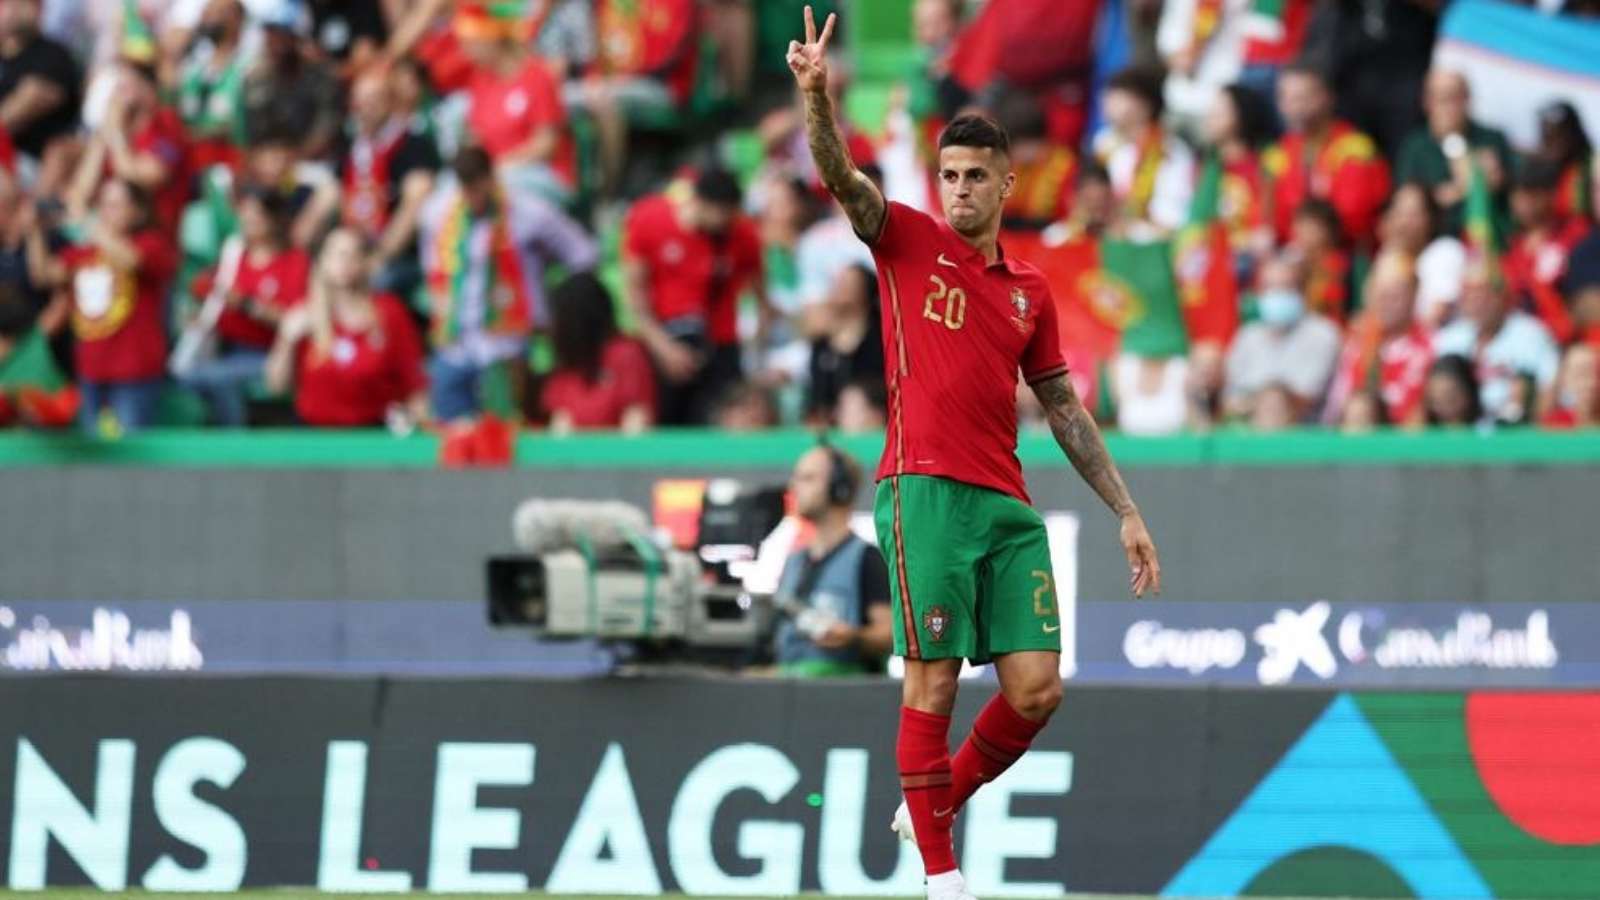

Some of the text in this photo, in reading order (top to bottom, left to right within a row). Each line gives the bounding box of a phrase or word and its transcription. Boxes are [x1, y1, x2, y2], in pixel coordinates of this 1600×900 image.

[923, 274, 966, 330] 20
[8, 736, 1074, 897] NS LEAGUE
